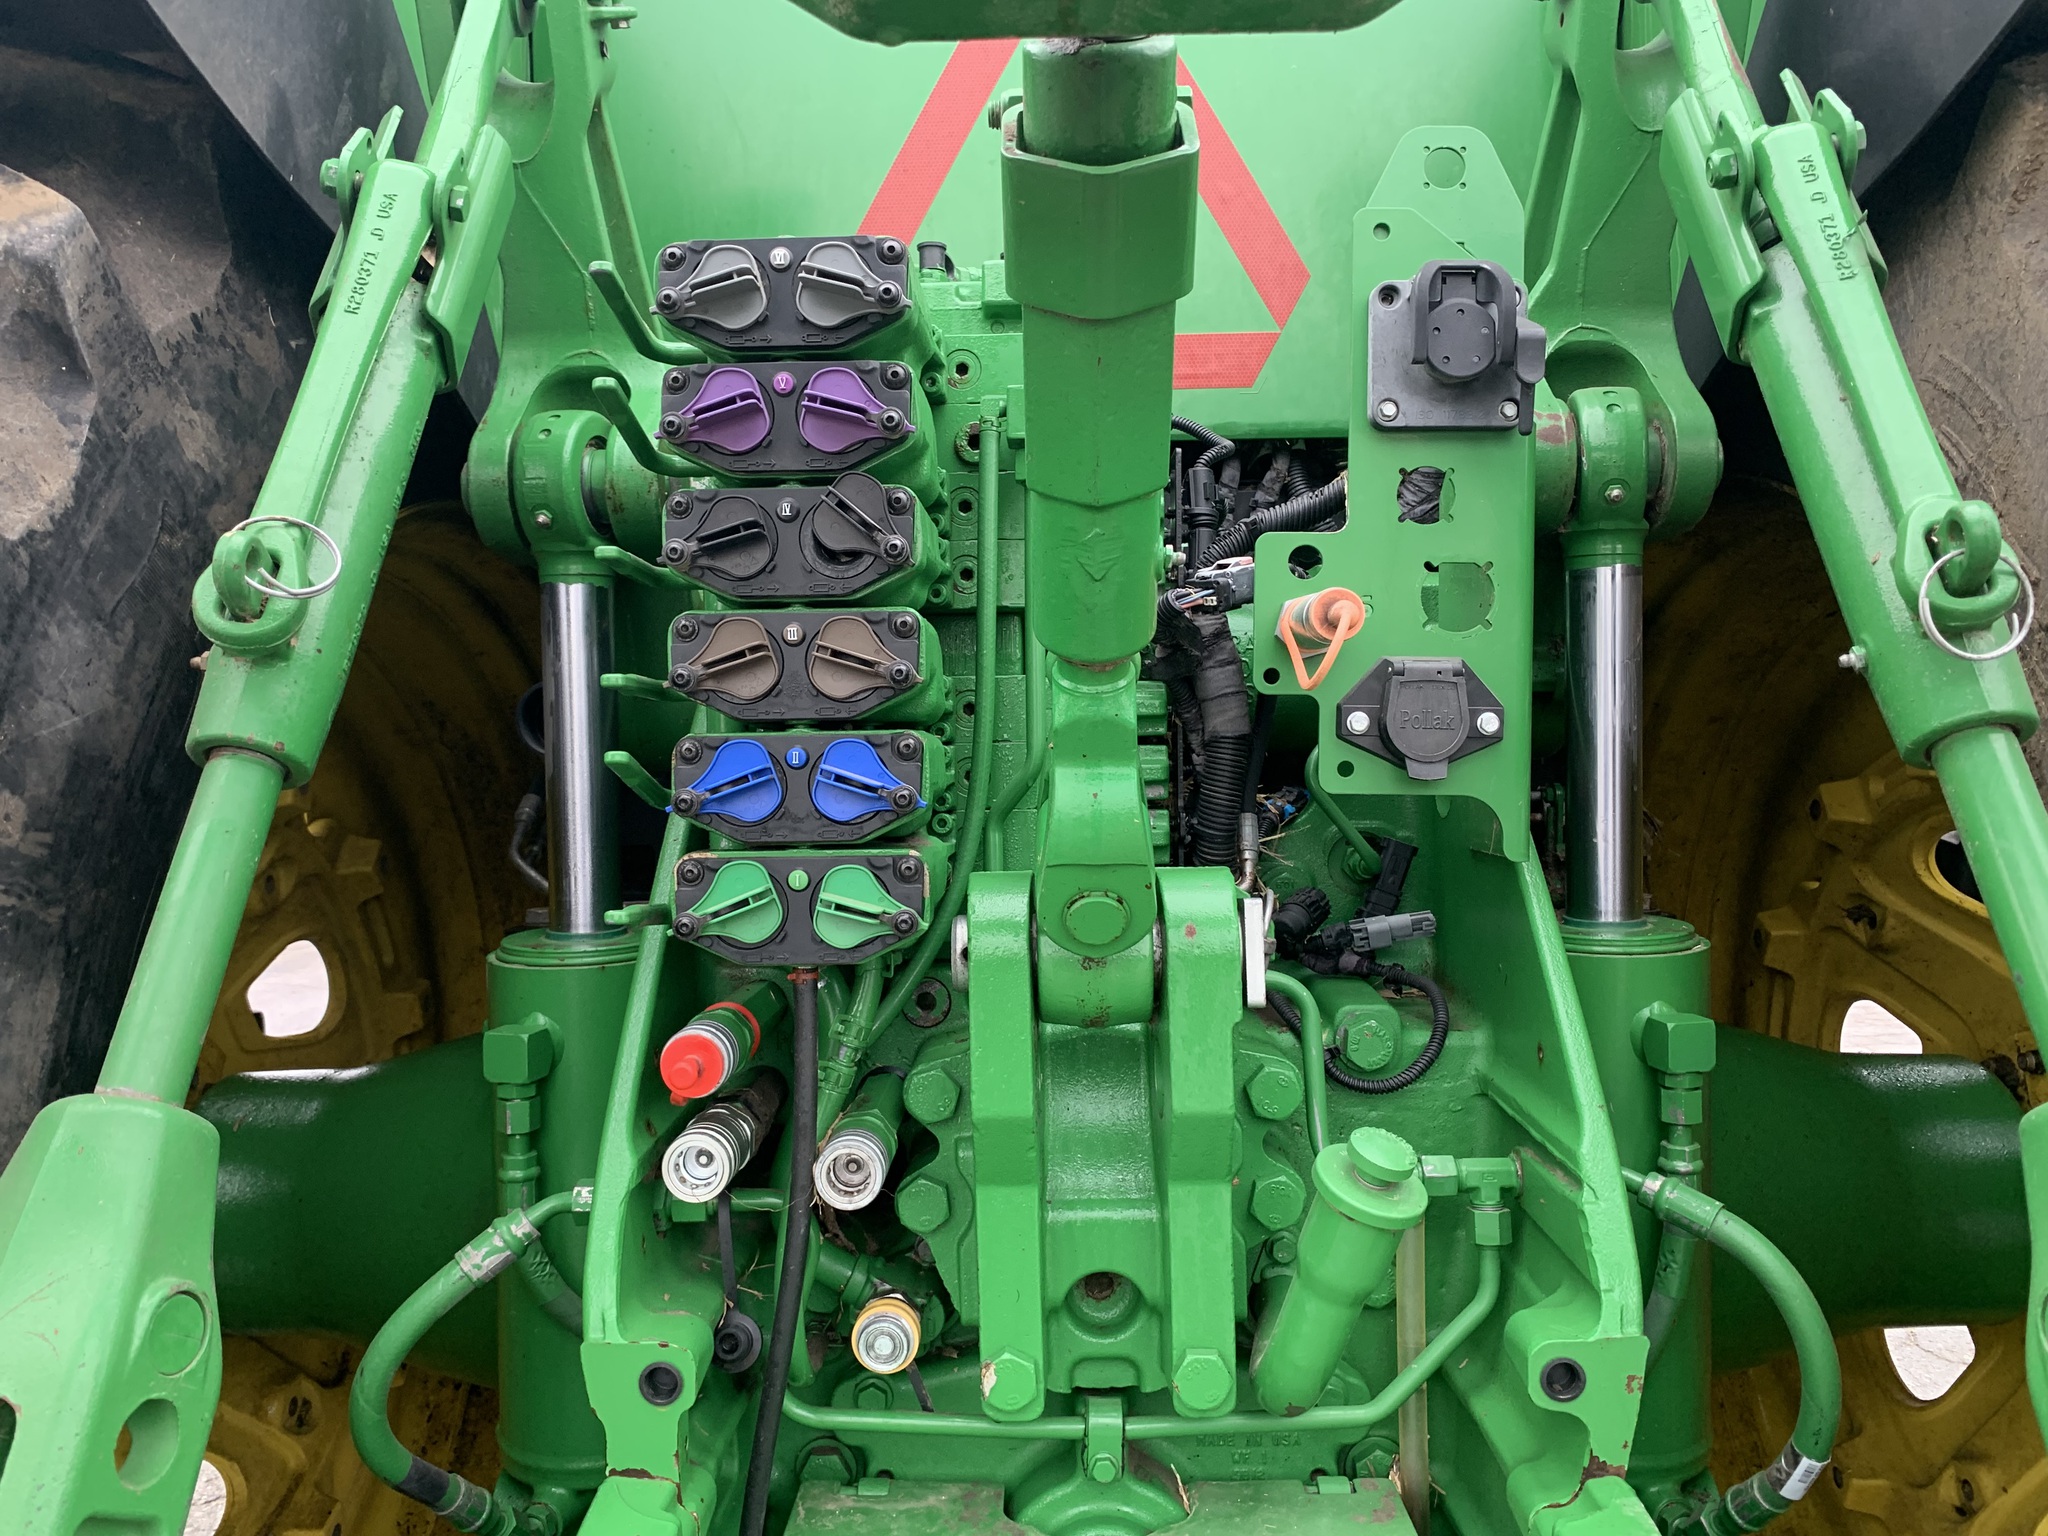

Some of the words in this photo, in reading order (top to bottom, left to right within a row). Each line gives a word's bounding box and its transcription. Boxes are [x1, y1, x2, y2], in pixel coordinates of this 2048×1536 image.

[1797, 154, 1819, 184] USA
[343, 251, 379, 315] R280371
[376, 193, 399, 220] USA
[777, 377, 787, 390] V
[781, 504, 792, 516] IV
[787, 627, 798, 640] III
[1399, 709, 1456, 731] Pollak
[791, 751, 800, 764] II
[1195, 1433, 1235, 1448] MADE
[1245, 1433, 1263, 1448] IN
[1271, 1431, 1301, 1447] USA
